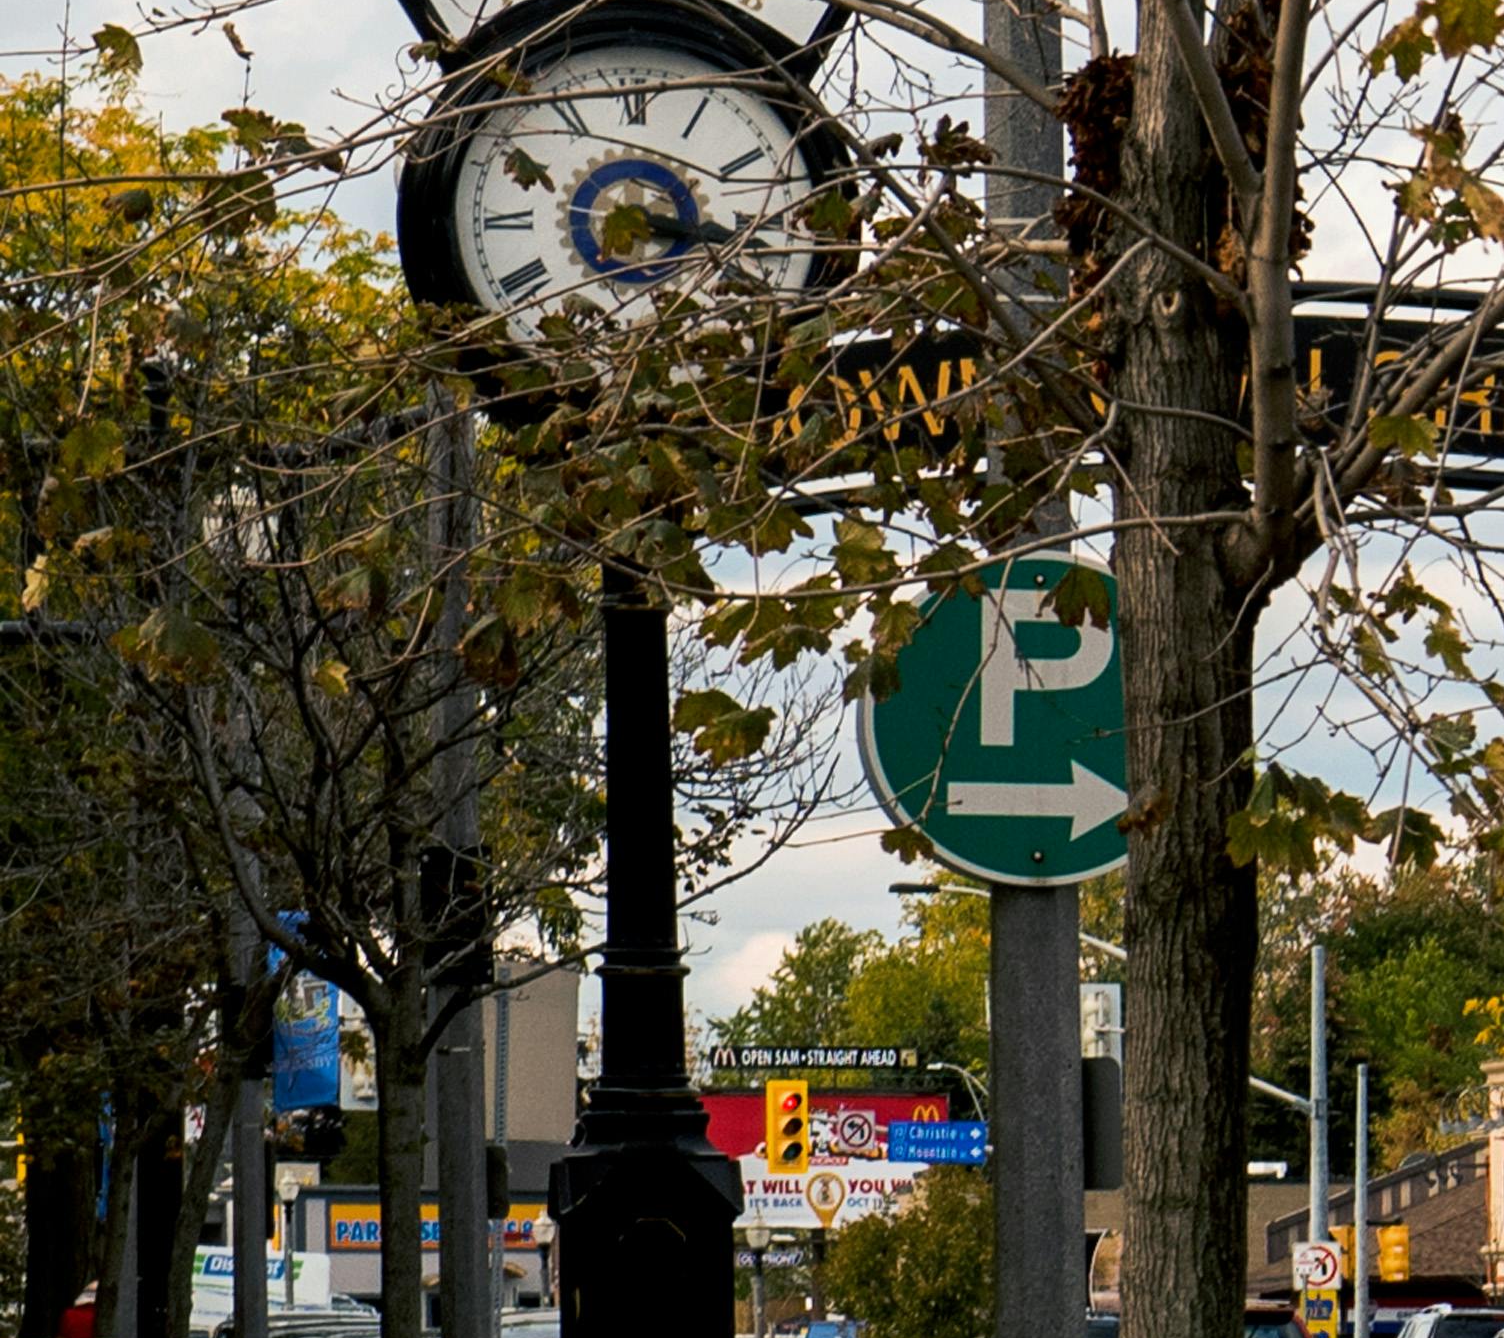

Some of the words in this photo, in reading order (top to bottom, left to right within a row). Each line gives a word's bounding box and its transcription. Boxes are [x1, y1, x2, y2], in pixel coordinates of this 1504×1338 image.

[980, 588, 1114, 747] P
[807, 1049, 858, 1066] STRAIGHT
[860, 1049, 896, 1066] AHEAD
[762, 1180, 803, 1194] WILL
